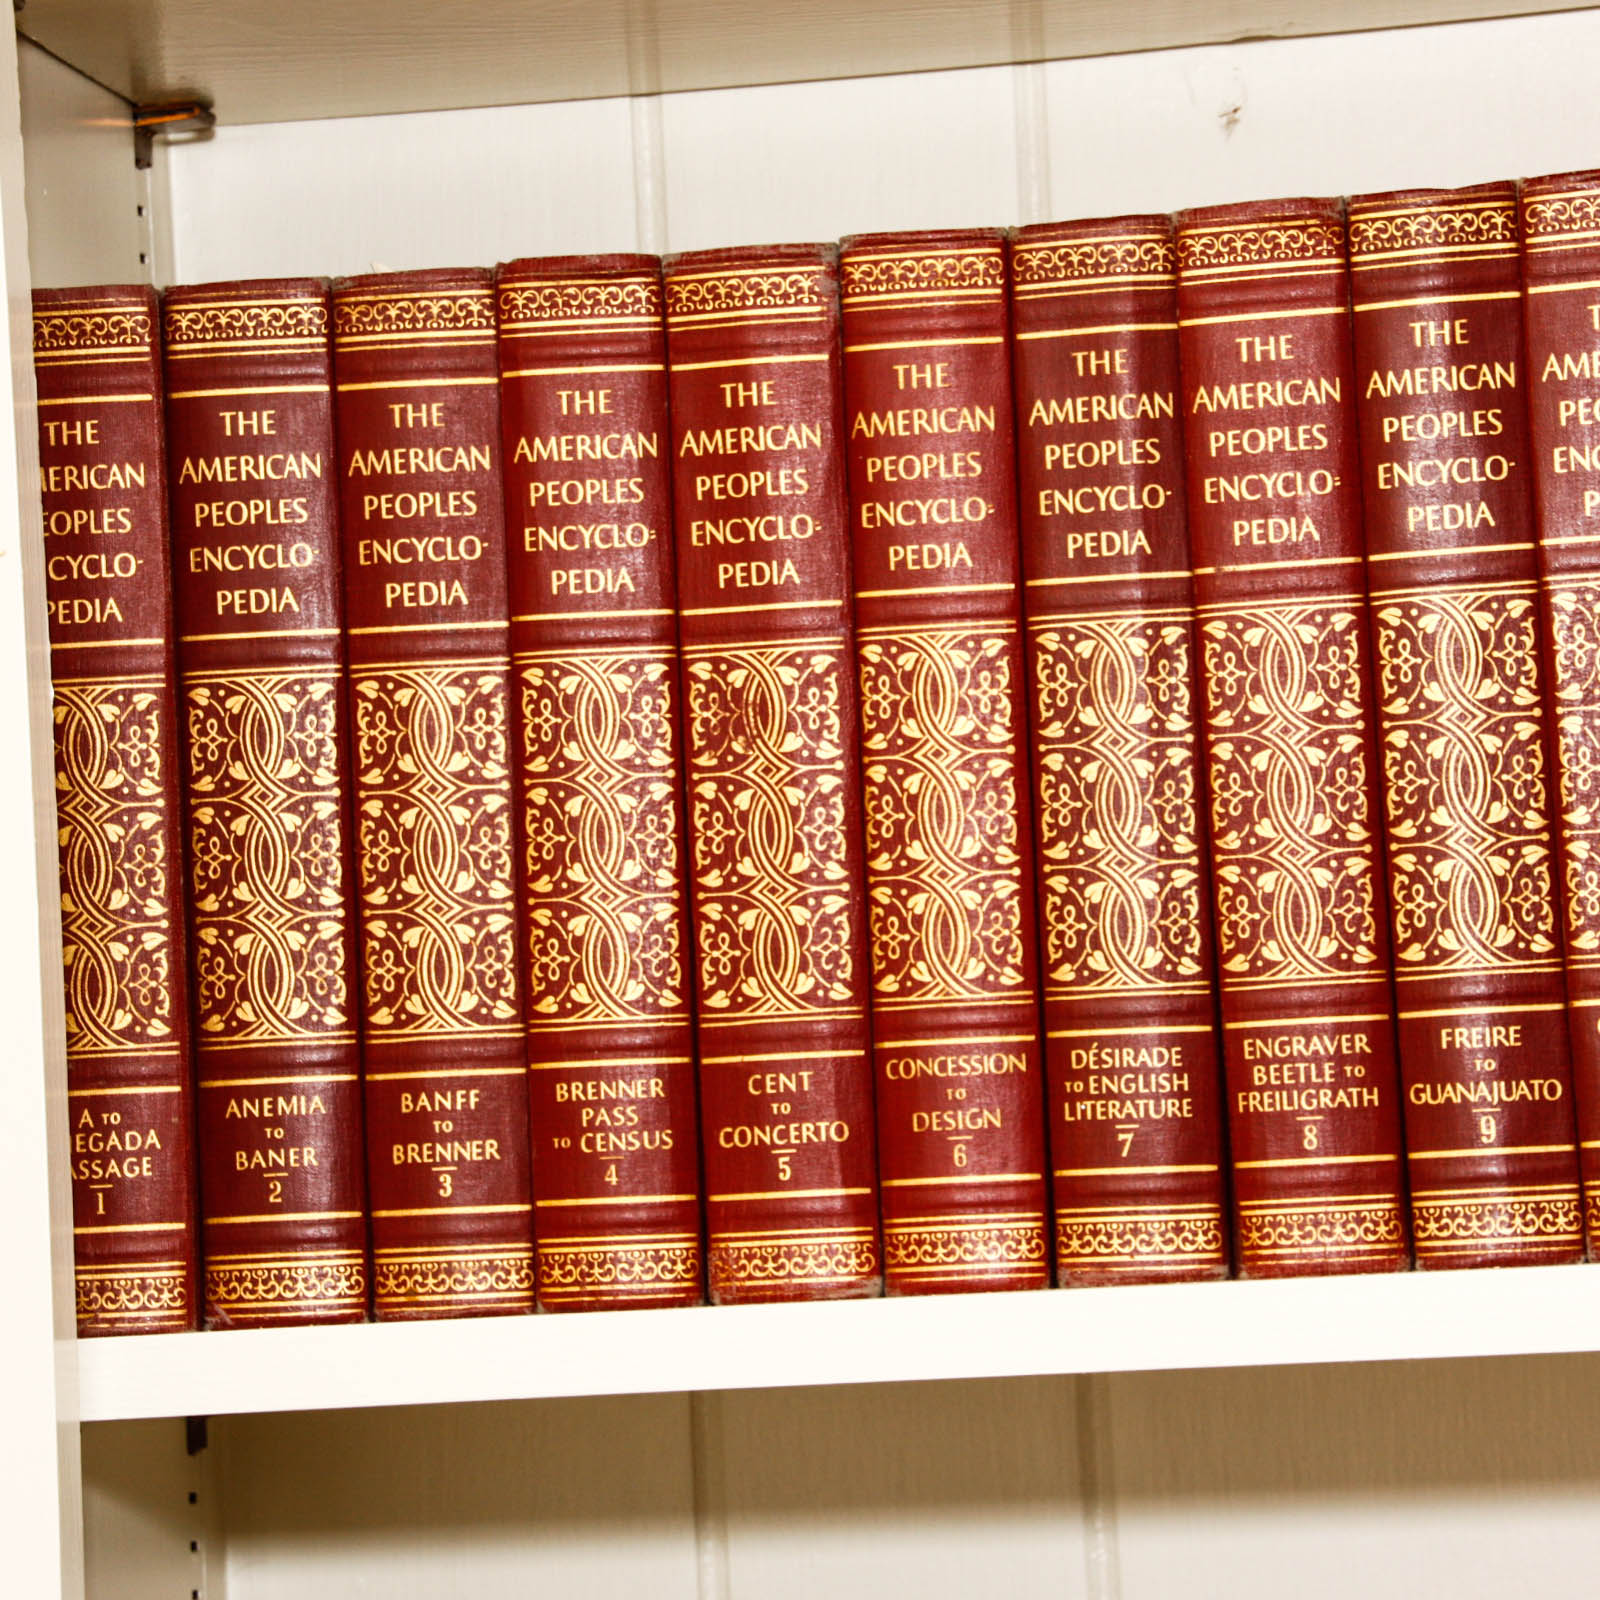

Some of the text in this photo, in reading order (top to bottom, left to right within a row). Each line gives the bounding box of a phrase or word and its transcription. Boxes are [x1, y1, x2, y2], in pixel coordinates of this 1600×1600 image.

[1408, 318, 1469, 348] THE
[1071, 347, 1129, 377] THE
[1234, 333, 1296, 364] THE
[892, 361, 953, 391] THE
[1366, 361, 1516, 399] AMERICAN
[555, 388, 614, 416] THE
[719, 379, 777, 408] THE
[1192, 376, 1341, 414] AMERICAN
[219, 409, 277, 437] THE
[389, 401, 446, 429] THE
[854, 404, 996, 438] AMERICAN
[1028, 391, 1174, 427] AMERICAN
[44, 419, 100, 446] THE
[1382, 408, 1503, 443] PEOPLES
[514, 431, 658, 463] AMERICAN
[679, 423, 822, 457] AMERICAN
[1209, 423, 1329, 458] PEOPLES
[179, 451, 322, 484] AMERICAN
[348, 444, 492, 477] AMERICAN
[866, 450, 983, 482] PEOPLES
[1044, 438, 1161, 471] PEOPLES
[529, 477, 645, 507] PEOPLES
[696, 467, 810, 501] PEOPLES
[195, 497, 310, 527] PEOPLES
[364, 489, 478, 520] PEOPLES
[1405, 500, 1496, 533] PEDIA
[1066, 528, 1153, 559] PEDIA
[1232, 514, 1320, 547] PEDIA
[888, 541, 975, 571] PEDIA
[551, 567, 637, 596] PEDIA
[718, 558, 801, 589] PEDIA
[216, 586, 302, 615] PEDIA
[385, 579, 470, 608] PEDIA
[1243, 1033, 1372, 1060] ENGRAVER
[1440, 1025, 1522, 1049] FREIRE
[884, 1051, 1028, 1082] CONCESSION
[1071, 1041, 1183, 1070] DÉSIRADE
[1472, 1057, 1497, 1072] TO
[748, 1070, 814, 1095] CENT
[1065, 1071, 1189, 1095] TO ENGLISH
[1253, 1061, 1366, 1086] BEETLE TO
[401, 1088, 480, 1113] BANFF
[556, 1077, 665, 1102] BRENNER
[946, 1087, 968, 1101] TO
[1238, 1087, 1379, 1113] FREILIGRATH
[1409, 1078, 1564, 1107] GUANAJUATO
[79, 1109, 121, 1128] A TO
[226, 1094, 328, 1118] ANEMIA
[581, 1104, 640, 1128] PASS
[770, 1102, 792, 1115] TO
[913, 1107, 1002, 1132] DESIGN
[1064, 1098, 1193, 1121] LITERATURE
[264, 1127, 285, 1140] TO
[432, 1119, 454, 1134] TO
[719, 1120, 850, 1148] CONCERTO
[1302, 1123, 1319, 1151] 8
[1477, 1113, 1497, 1145] 9
[393, 1138, 501, 1165] BRENNER
[552, 1129, 673, 1153] TO CENSUS
[1117, 1131, 1135, 1158] 7
[236, 1145, 320, 1170] BANER
[777, 1155, 792, 1181] 5
[953, 1143, 969, 1168] 6
[438, 1173, 453, 1198] 3
[604, 1163, 619, 1186] 4
[96, 1191, 107, 1216] 1
[268, 1180, 283, 1203] 2
